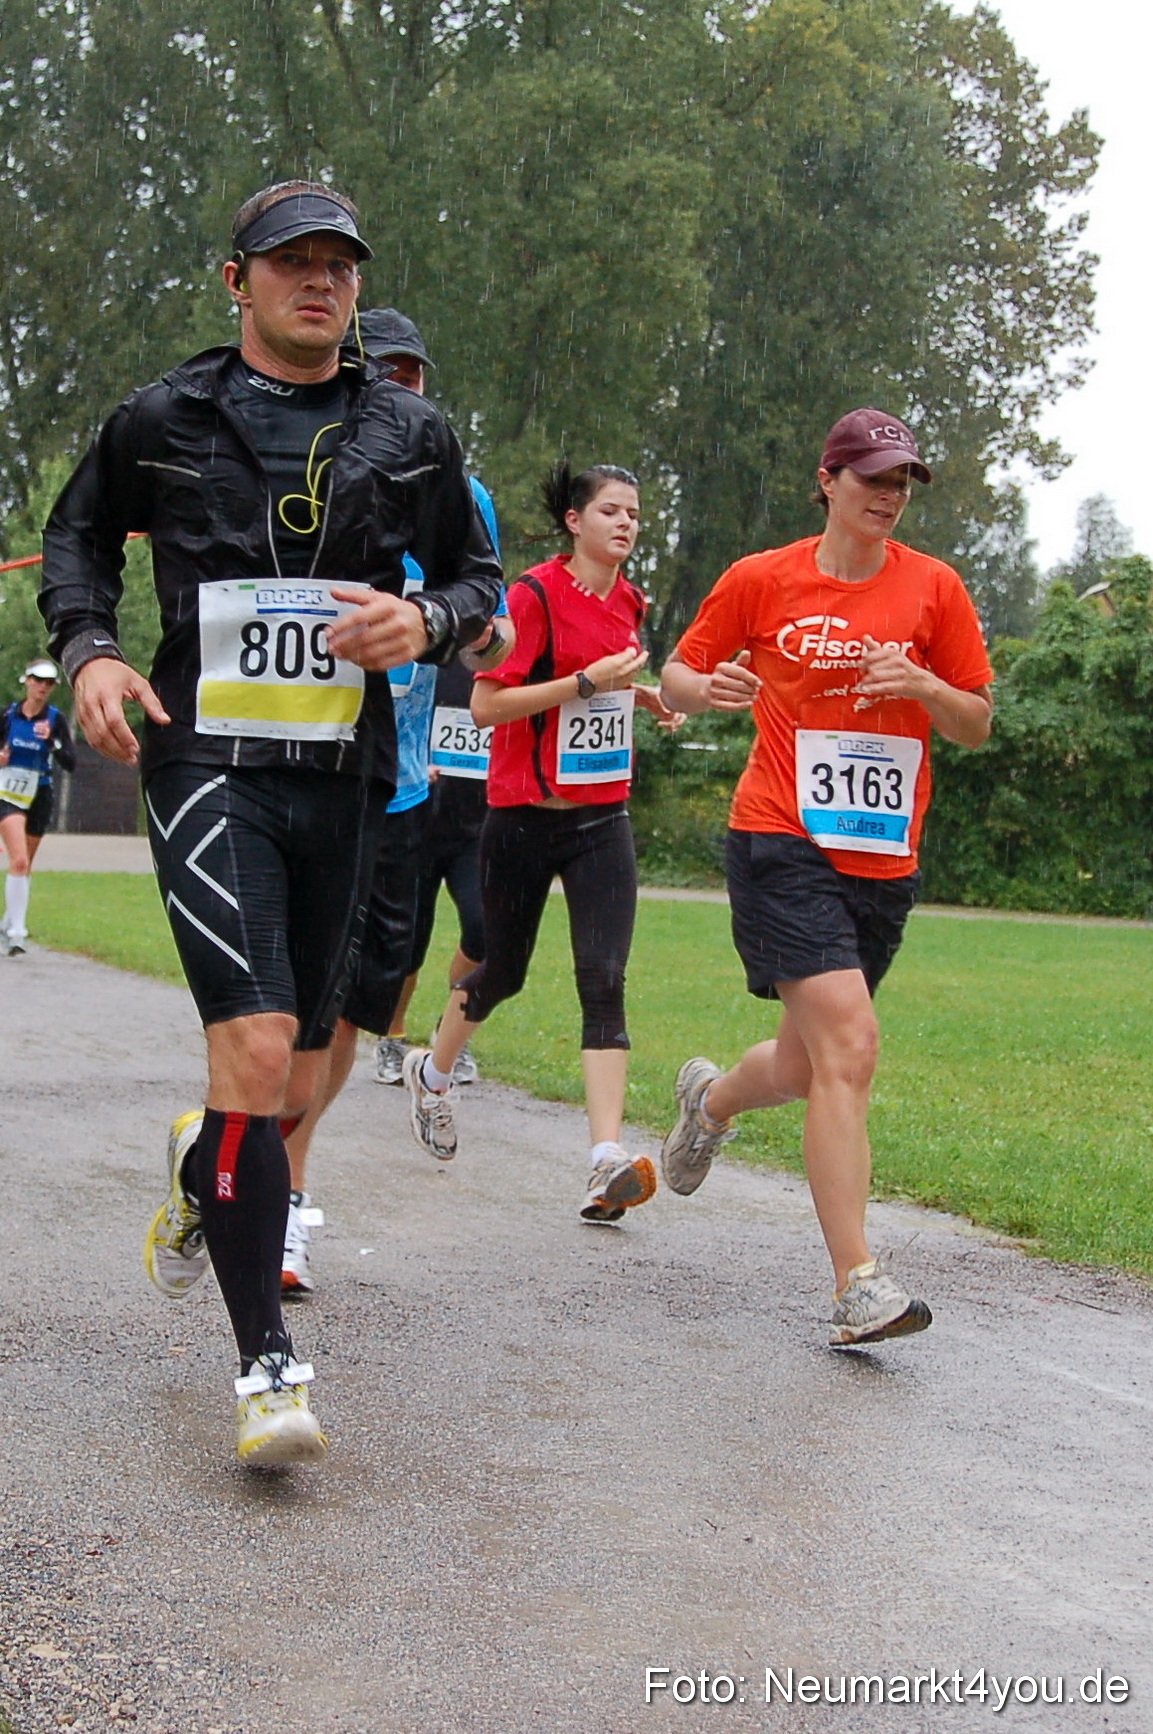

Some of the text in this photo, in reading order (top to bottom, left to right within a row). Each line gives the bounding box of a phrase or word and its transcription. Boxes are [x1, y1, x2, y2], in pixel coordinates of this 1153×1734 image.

[256, 589, 323, 605] BOCK
[240, 621, 336, 680] 809
[439, 725, 493, 752] 2534
[568, 714, 625, 749] 2341
[811, 762, 903, 810] 3163
[836, 816, 886, 835] Andrea
